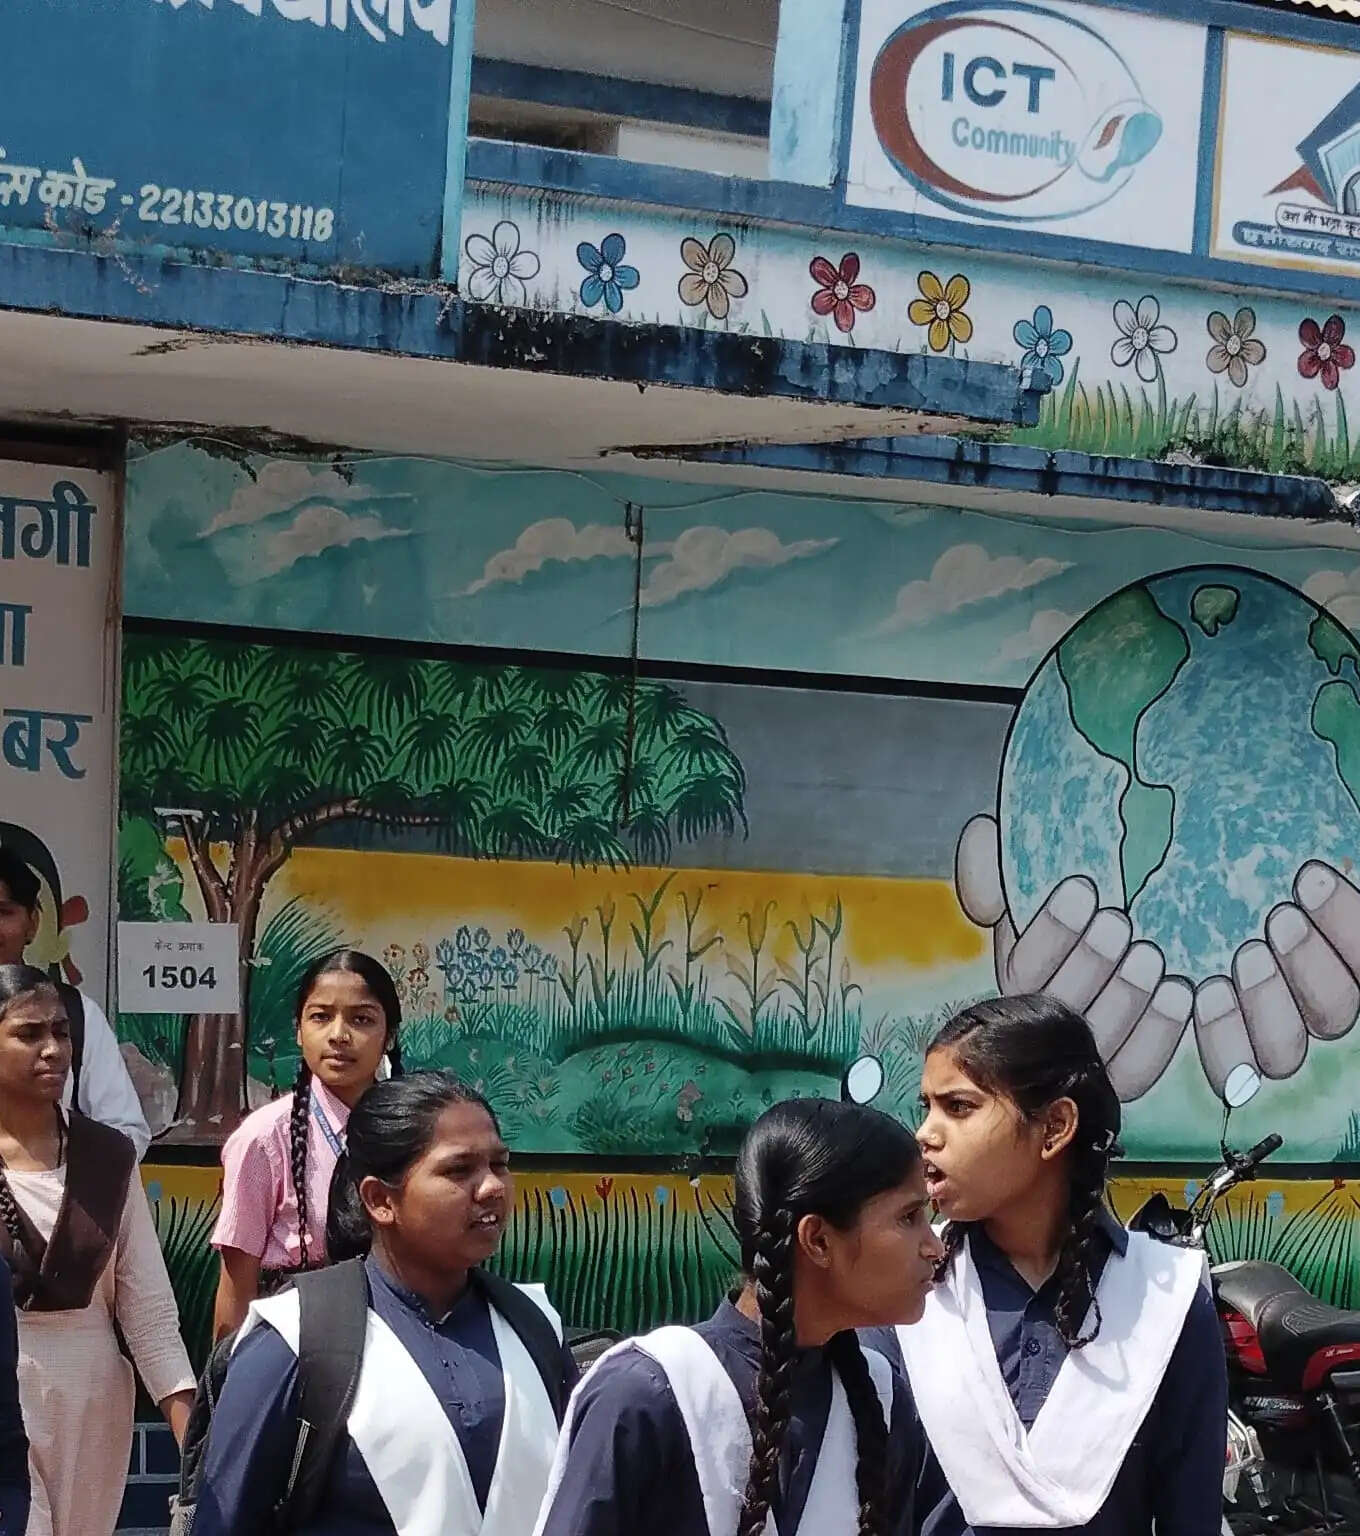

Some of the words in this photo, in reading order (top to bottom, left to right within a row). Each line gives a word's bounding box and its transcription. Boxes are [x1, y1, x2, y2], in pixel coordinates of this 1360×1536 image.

[940, 52, 1056, 114] ICT
[951, 117, 1077, 167] Community
[39, 157, 116, 214] कोड
[3, 708, 93, 780] बर
[142, 965, 217, 990] 1504
